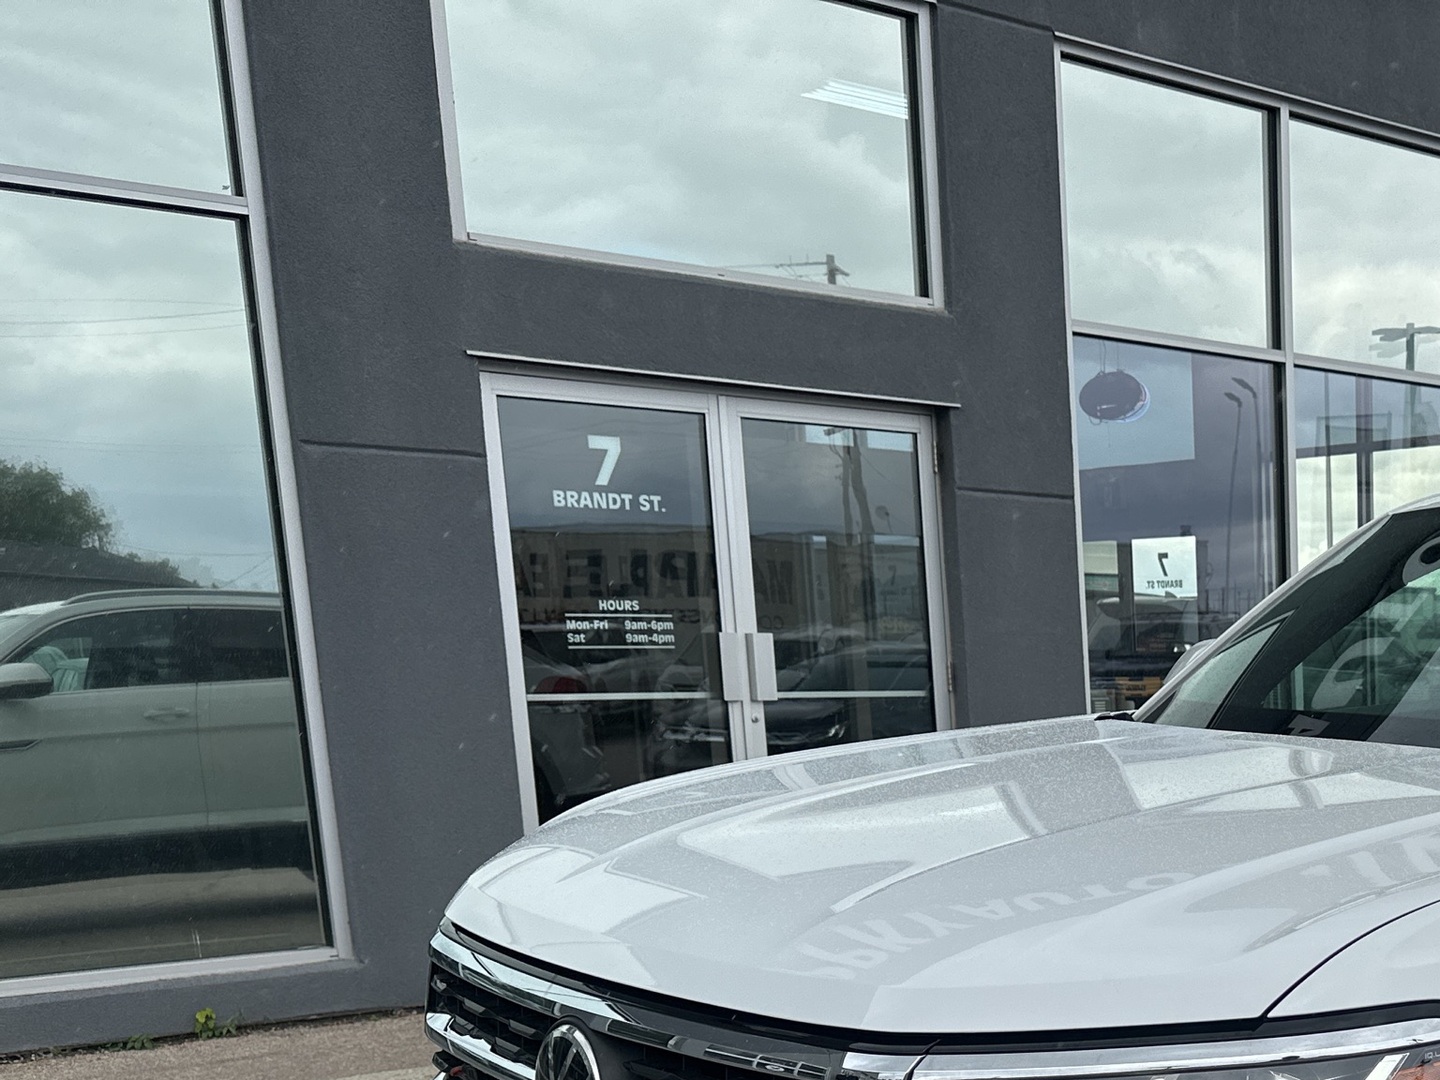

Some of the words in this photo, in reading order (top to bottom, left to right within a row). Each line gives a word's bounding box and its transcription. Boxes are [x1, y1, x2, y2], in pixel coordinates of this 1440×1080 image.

[587, 434, 621, 486] 7
[552, 489, 633, 511] BRANDT
[639, 494, 666, 513] ST.
[598, 599, 640, 612] HOURS
[566, 619, 609, 630] Mon-Fri
[624, 619, 674, 633] 9am-6pm
[567, 632, 586, 644] Sat
[625, 632, 675, 646] 9am-4pm
